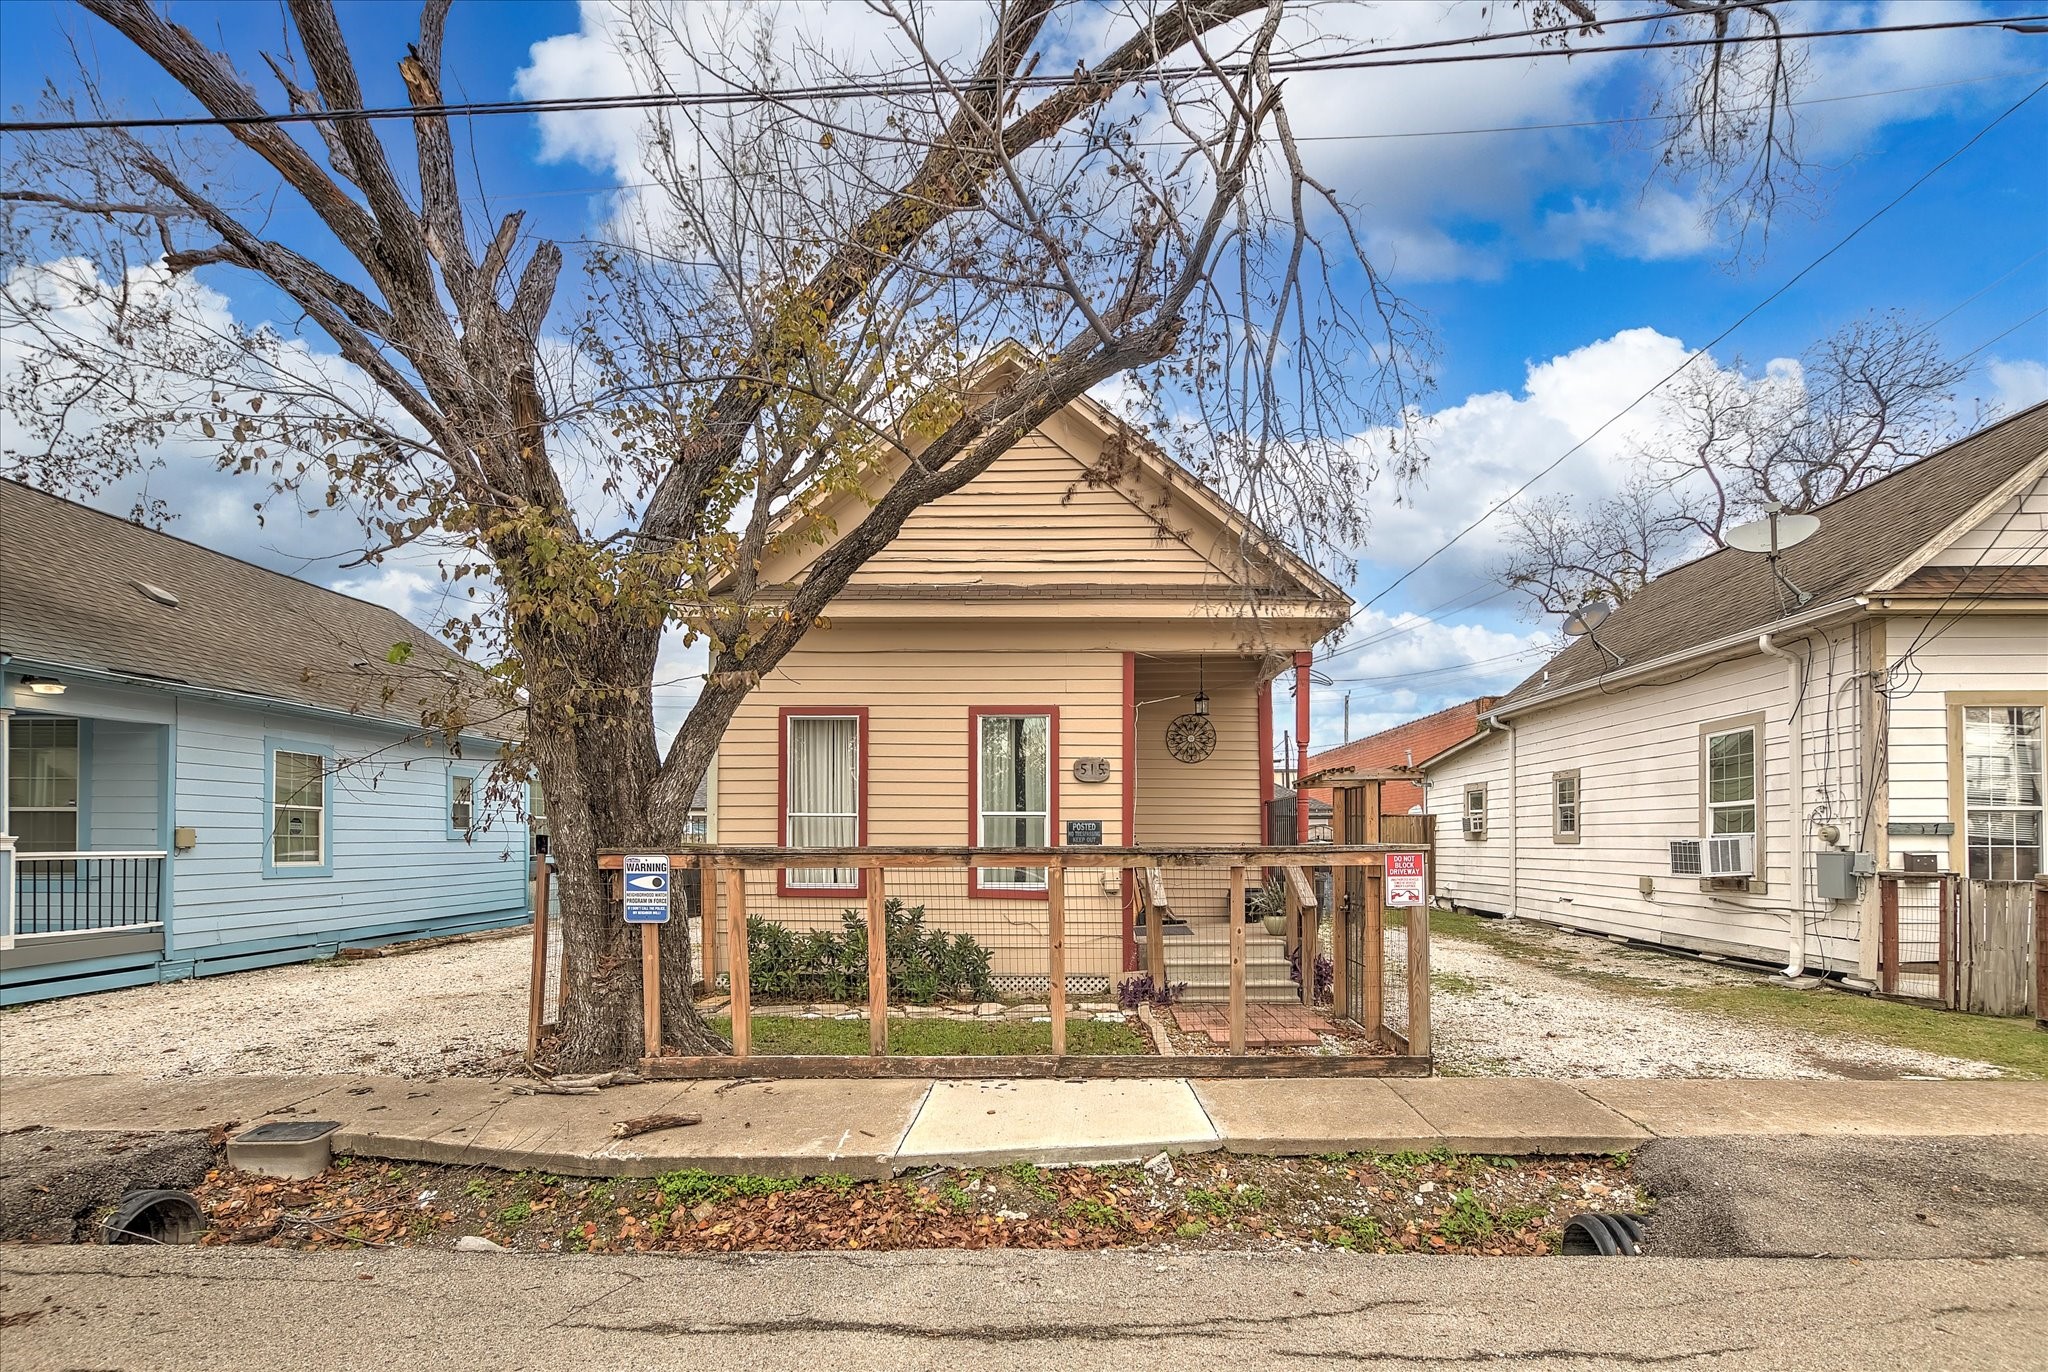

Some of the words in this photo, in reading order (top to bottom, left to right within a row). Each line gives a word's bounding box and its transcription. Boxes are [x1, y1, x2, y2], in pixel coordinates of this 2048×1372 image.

[1080, 763, 1106, 775] 515
[1072, 822, 1097, 831] POSTED
[626, 863, 667, 872] WARNING
